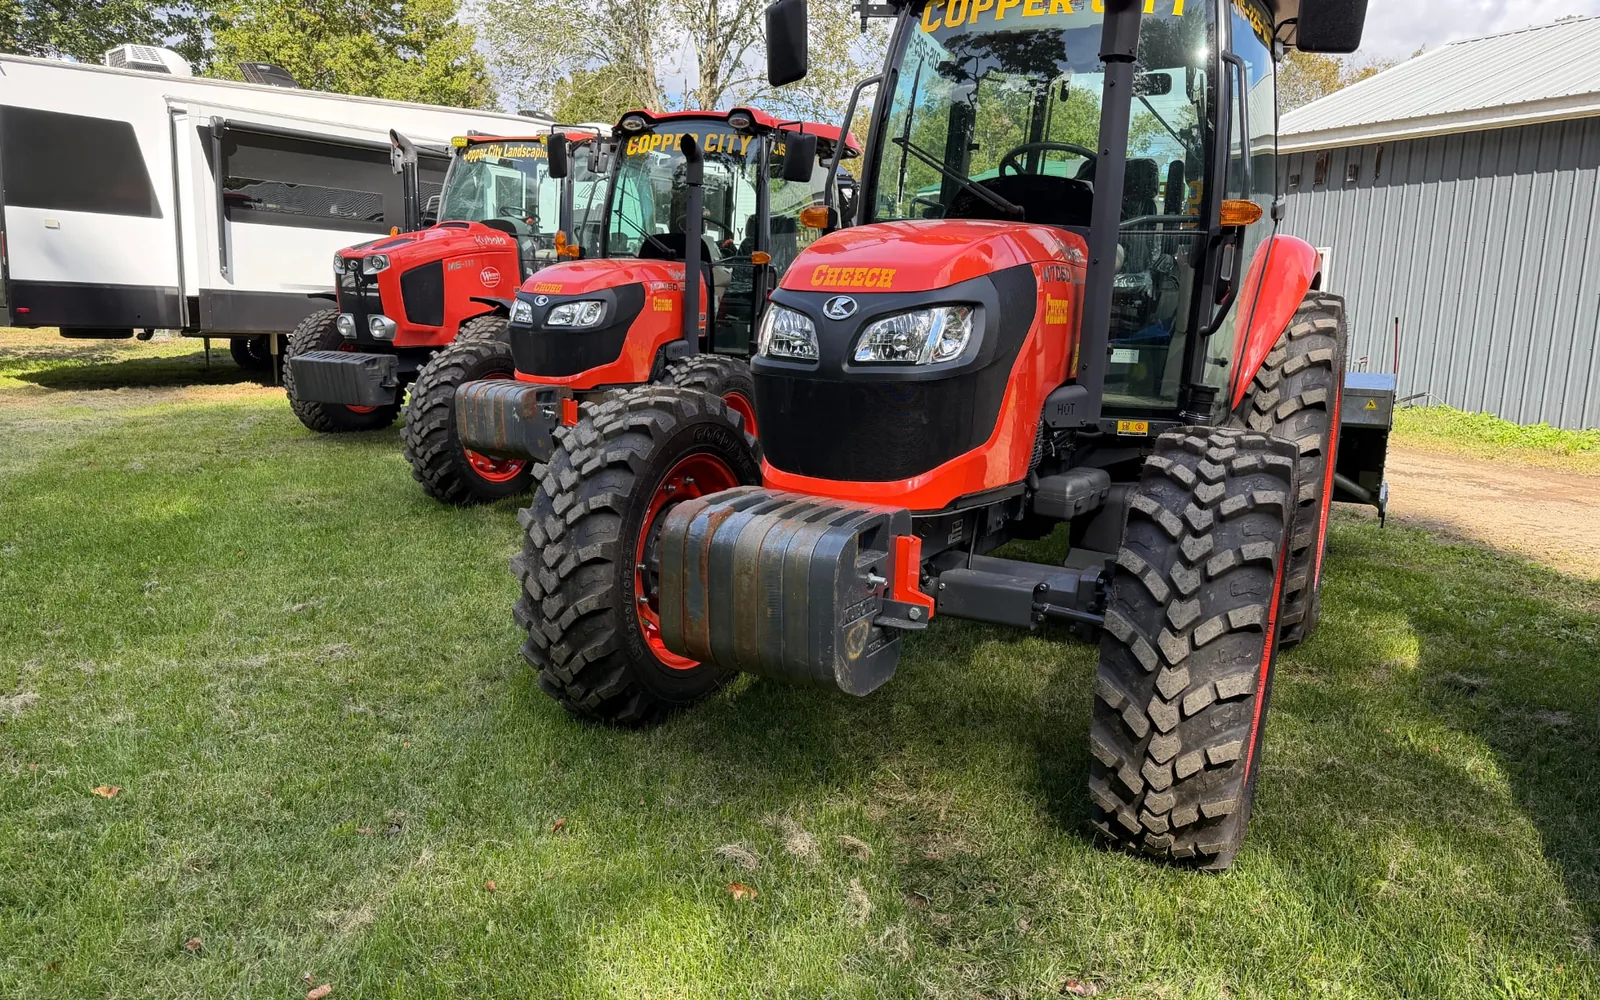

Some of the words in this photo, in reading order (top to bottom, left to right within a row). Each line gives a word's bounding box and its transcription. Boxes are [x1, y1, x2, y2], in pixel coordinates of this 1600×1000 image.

[921, 0, 1067, 33] COPP
[488, 143, 503, 161] City
[704, 133, 753, 156] CITY
[474, 234, 507, 246] Kubota
[810, 264, 897, 288] CHEECH
[1056, 402, 1076, 416] HOT
